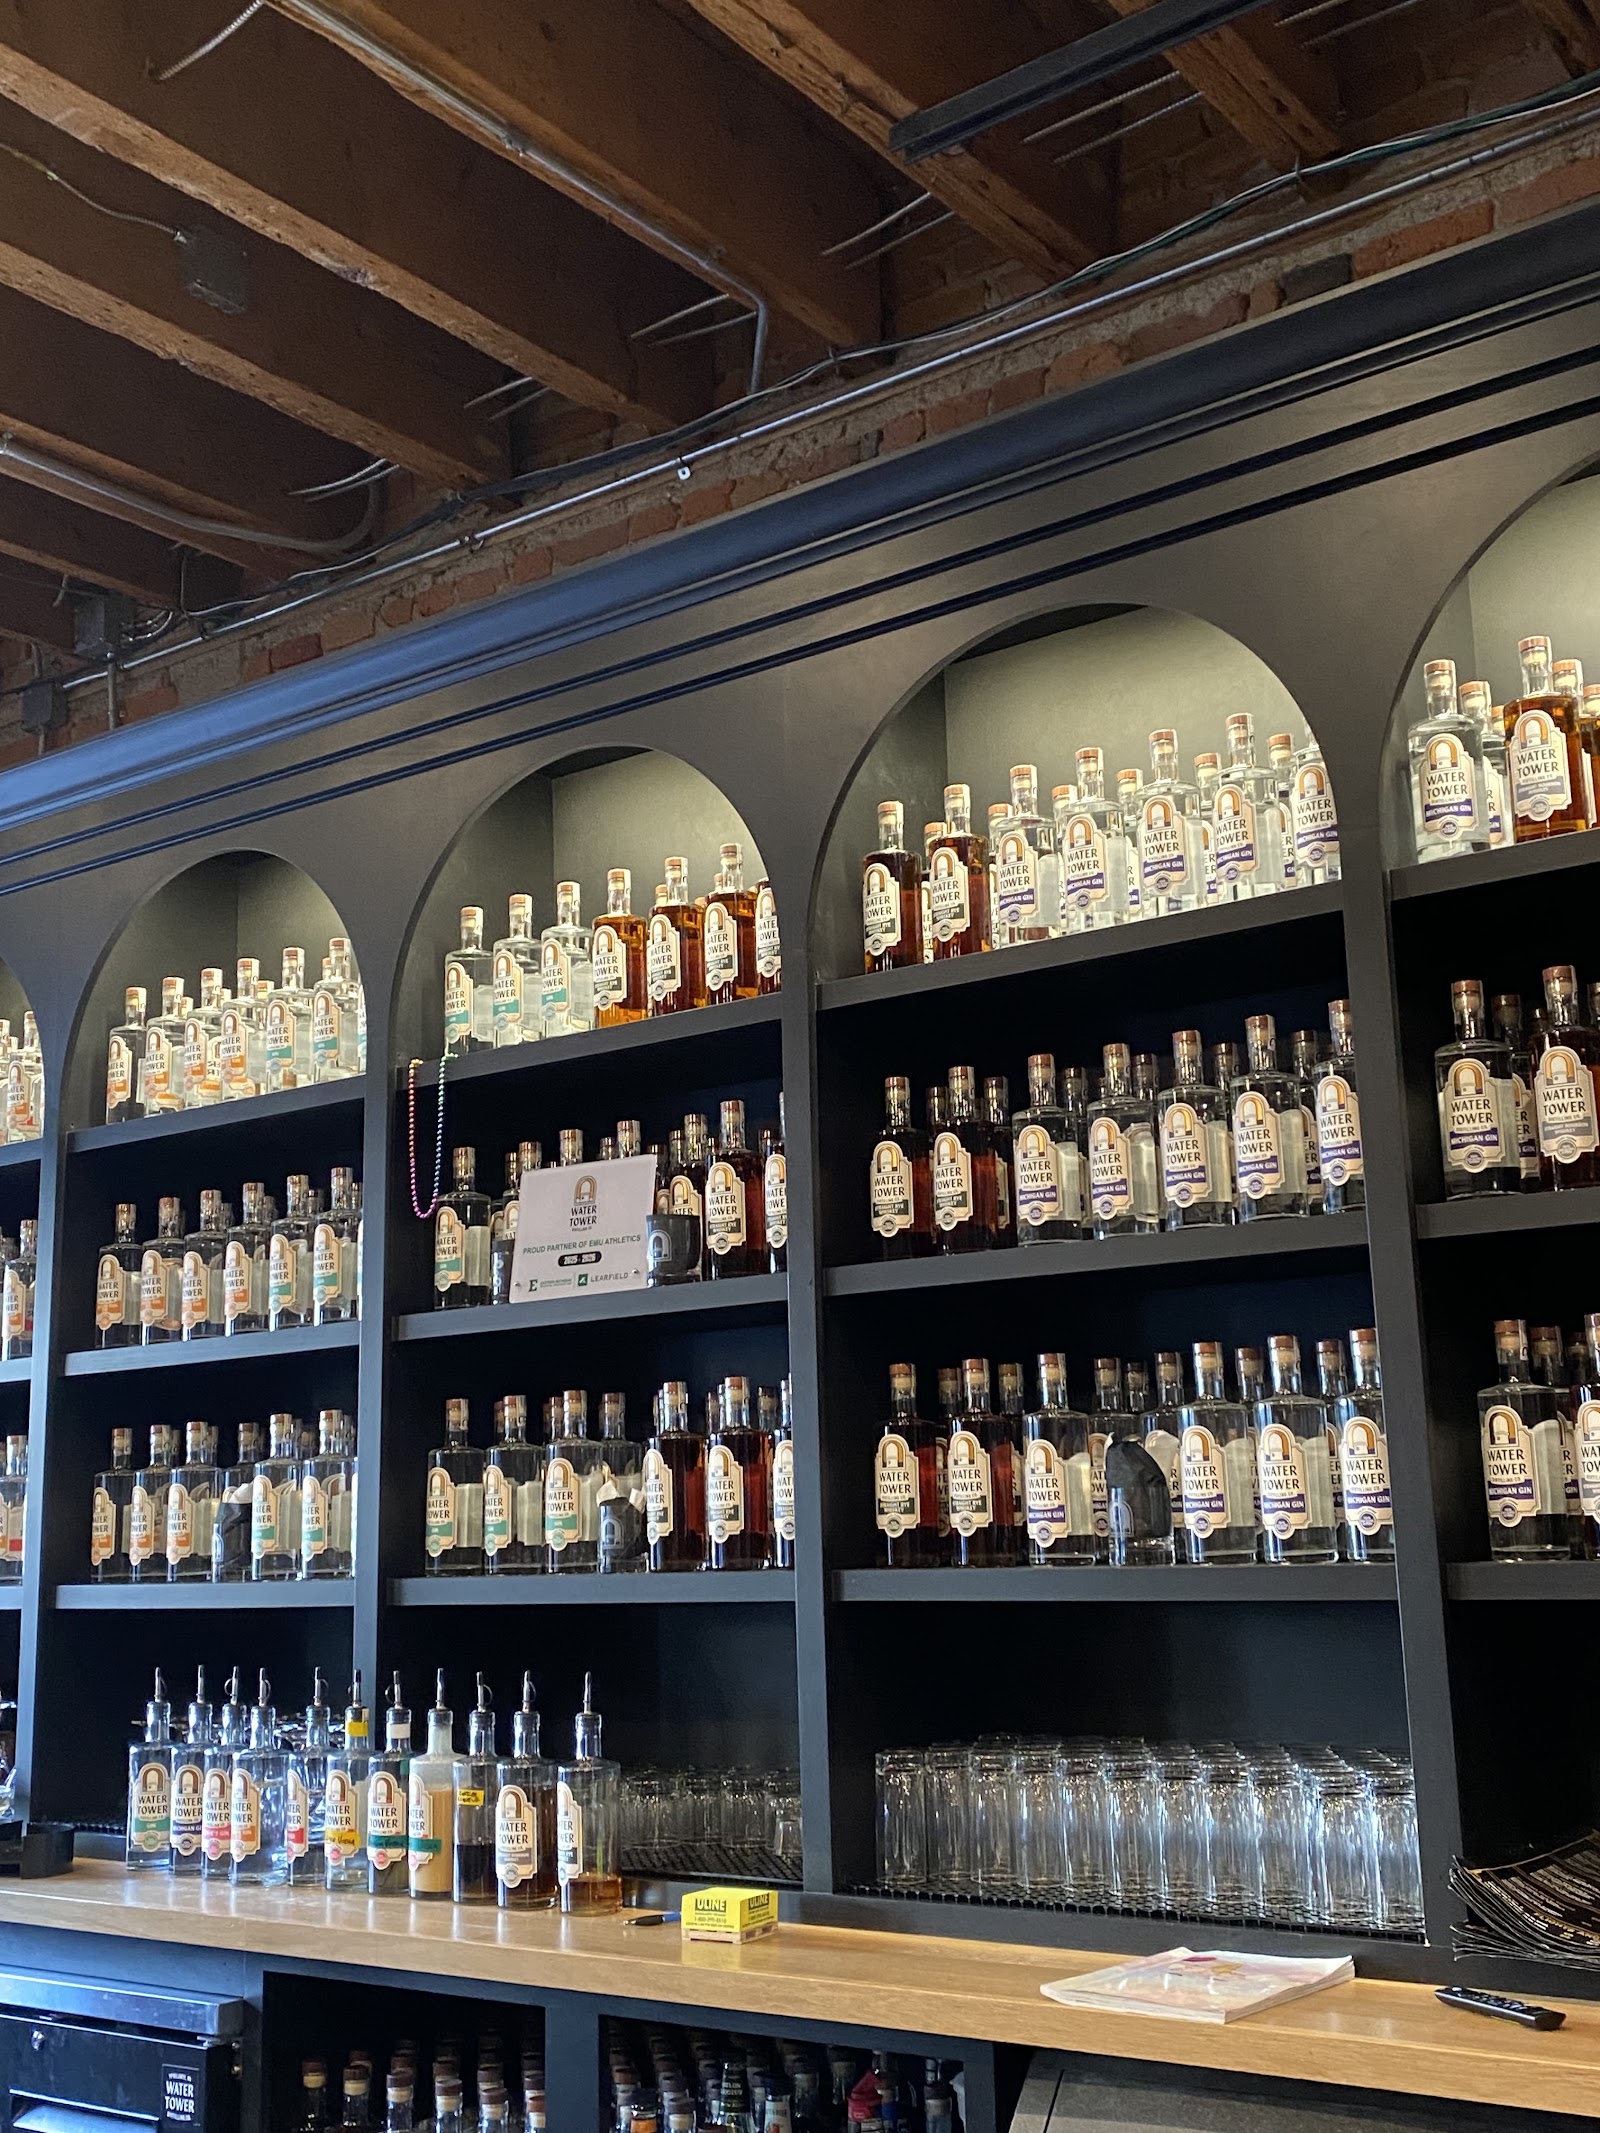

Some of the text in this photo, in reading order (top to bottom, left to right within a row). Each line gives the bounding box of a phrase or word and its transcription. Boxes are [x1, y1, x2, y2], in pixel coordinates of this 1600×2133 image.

[1518, 749, 1556, 764] WATER
[1517, 762, 1559, 778] TOWER
[1427, 772, 1465, 786] WATER
[1426, 784, 1467, 799] TOWER
[1297, 799, 1330, 813] WATER
[1426, 806, 1458, 817] MICHIGAN
[1297, 811, 1334, 825] TOWER
[1216, 820, 1246, 833] WATER
[1144, 831, 1177, 845] WATER
[1216, 832, 1248, 845] TOWER
[1326, 830, 1338, 838] GIN
[1144, 843, 1179, 857] TOWER
[1240, 851, 1252, 859] GIN
[1067, 849, 1097, 862] WATER
[1067, 860, 1099, 874] TOWER
[1172, 860, 1184, 868] GIN
[1000, 865, 1028, 878] WATER
[933, 880, 958, 893] WATER
[1000, 877, 1030, 889] TOWER
[1092, 877, 1103, 886] GIN
[866, 896, 890, 908] WATER
[933, 891, 960, 904] TOWER
[866, 907, 892, 919] TOWER
[707, 933, 728, 943] ATER
[652, 945, 671, 955] ATER
[707, 944, 730, 954] OWER
[594, 956, 617, 966] WATER
[652, 955, 672, 965] OWER
[543, 968, 562, 977] ATER
[495, 980, 515, 989] ATER
[542, 978, 564, 987] OWER
[446, 991, 465, 1000] ATER
[495, 989, 516, 999] OWER
[446, 1000, 466, 1009] OWER
[315, 1017, 334, 1026] ATER
[268, 1026, 289, 1035] ATER
[315, 1027, 335, 1036] OWER
[268, 1035, 289, 1044] OWER
[1542, 1087, 1583, 1101] WATER
[1451, 1099, 1490, 1113] WATER
[1543, 1101, 1586, 1116] TOWER
[1320, 1113, 1352, 1127] WATER
[1451, 1112, 1493, 1126] TOWER
[1238, 1129, 1270, 1142] WATER
[1320, 1125, 1355, 1139] TOWER
[1451, 1135, 1484, 1145] MICHIGAN
[1166, 1140, 1198, 1152] WATER
[1238, 1141, 1273, 1155] TOWER
[1347, 1147, 1359, 1155] GIN
[1092, 1153, 1121, 1165] WATER
[1166, 1152, 1201, 1164] TOWER
[1020, 1161, 1051, 1172] WATER
[1265, 1161, 1277, 1169] GIN
[936, 1167, 961, 1178] WATER
[1092, 1165, 1122, 1178] TOWER
[1194, 1170, 1205, 1178] GIN
[874, 1175, 903, 1186] WATER
[1020, 1172, 1053, 1183] TOWER
[935, 1179, 963, 1190] TOWER
[1115, 1184, 1127, 1192] GIN
[874, 1187, 905, 1197] TOWER
[709, 1194, 736, 1205] WATER
[571, 1205, 597, 1216] WATER
[709, 1206, 737, 1216] TOWER
[570, 1216, 597, 1227] TOWER
[437, 1237, 457, 1246] ATER
[523, 1244, 545, 1254] PROUD
[547, 1243, 577, 1252] PARTNER
[589, 1239, 604, 1247] EMU
[605, 1235, 641, 1245] ATHLETICS
[436, 1246, 457, 1255] OWER
[315, 1252, 334, 1261] ATER
[315, 1262, 335, 1271] OWER
[142, 1278, 161, 1286] ATER
[591, 1272, 628, 1282] LEARFIELD
[99, 1281, 118, 1290] ATER
[184, 1279, 202, 1287] ATER
[529, 1279, 538, 1292] E
[98, 1291, 119, 1299] OWER
[142, 1286, 162, 1295] OWER
[1487, 1449, 1525, 1461] WATER
[1346, 1459, 1383, 1472] WATER
[1488, 1463, 1527, 1476] TOWER
[951, 1469, 981, 1480] WATER
[1184, 1465, 1217, 1478] WATER
[1262, 1465, 1297, 1477] WATER
[879, 1471, 910, 1482] WATER
[1346, 1472, 1386, 1485] TOWER
[646, 1483, 664, 1492] ATER
[710, 1480, 734, 1490] WATER
[951, 1481, 982, 1492] TOWER
[1029, 1478, 1058, 1489] WATER
[1184, 1479, 1219, 1490] TOWER
[1263, 1478, 1299, 1490] TOWER
[879, 1484, 911, 1494] TOWER
[1518, 1486, 1532, 1494] GIN
[548, 1491, 573, 1501] WATER
[1029, 1491, 1060, 1501] TOWER
[1377, 1494, 1390, 1502] GIN
[428, 1499, 449, 1508] ATER
[486, 1498, 503, 1506] ATER
[169, 1513, 186, 1521] ATER
[428, 1510, 450, 1519] OWER
[485, 1509, 504, 1517] OWER
[1053, 1510, 1064, 1518] GIN
[169, 1523, 187, 1531] OWER
[138, 1795, 167, 1804] WATER
[175, 1797, 202, 1806] WATER
[138, 1805, 168, 1814] TOWER
[175, 1807, 202, 1817] TOWER
[233, 1803, 252, 1811] ATER
[327, 1805, 350, 1814] WATER
[371, 1808, 397, 1817] WATER
[370, 1819, 398, 1828] TOWER
[499, 1822, 527, 1832] WATER
[696, 1899, 726, 1911] ULINE
[749, 1894, 769, 1909] ULINE
[166, 2080, 194, 2098] WATER
[164, 2096, 194, 2114] TOWER
